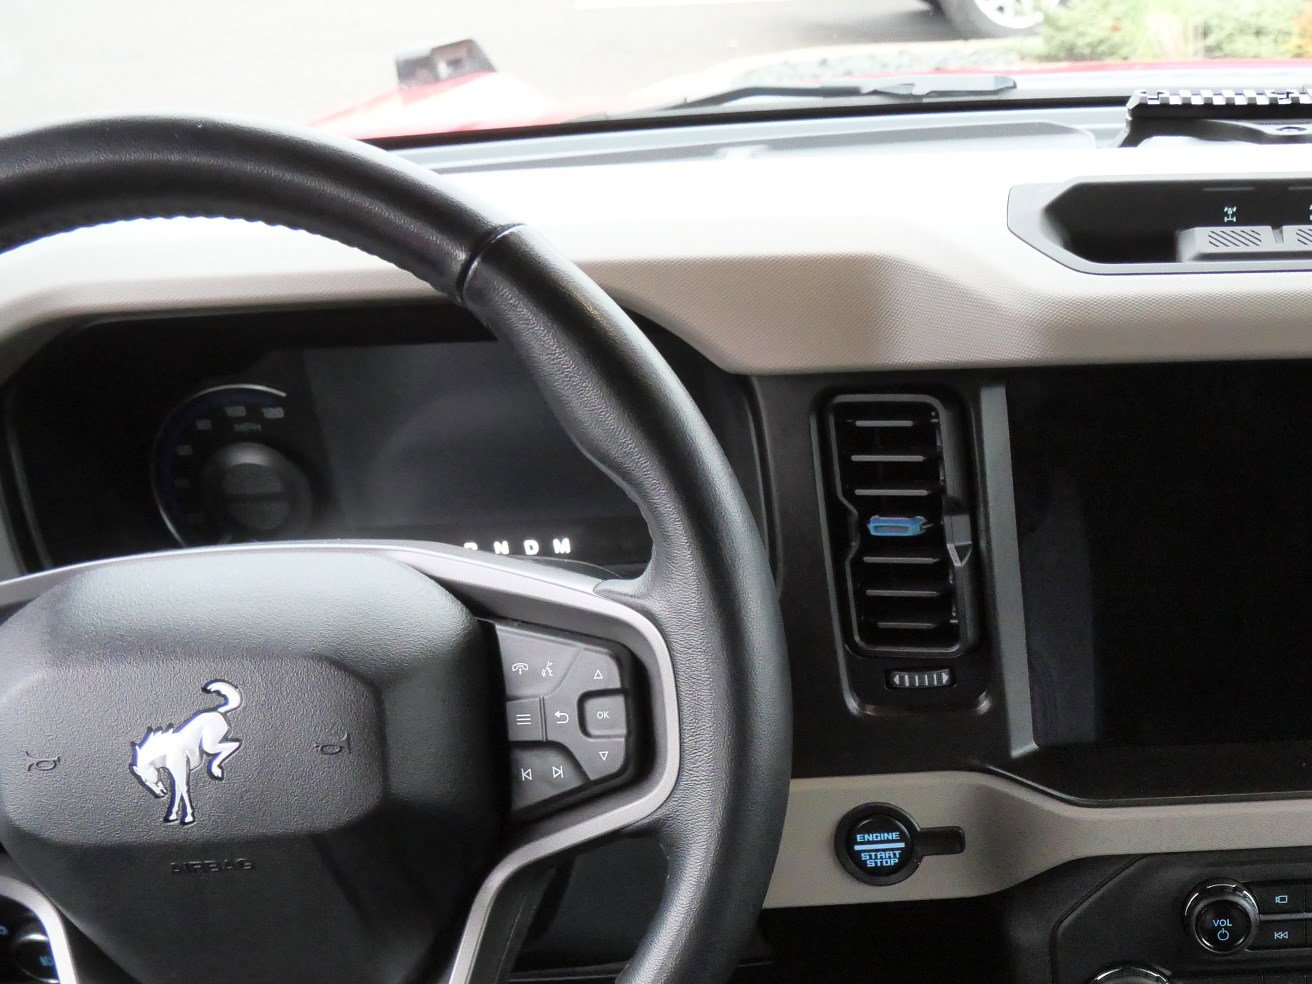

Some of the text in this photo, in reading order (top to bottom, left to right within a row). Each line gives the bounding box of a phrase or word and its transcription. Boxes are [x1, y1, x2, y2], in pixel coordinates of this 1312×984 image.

[493, 540, 510, 555] N
[523, 539, 540, 556] D
[552, 537, 572, 554] M
[596, 711, 610, 719] OK
[856, 831, 901, 842] ENGINE
[861, 850, 902, 861] START
[866, 858, 899, 868] STOP
[1212, 918, 1233, 928] VOL
